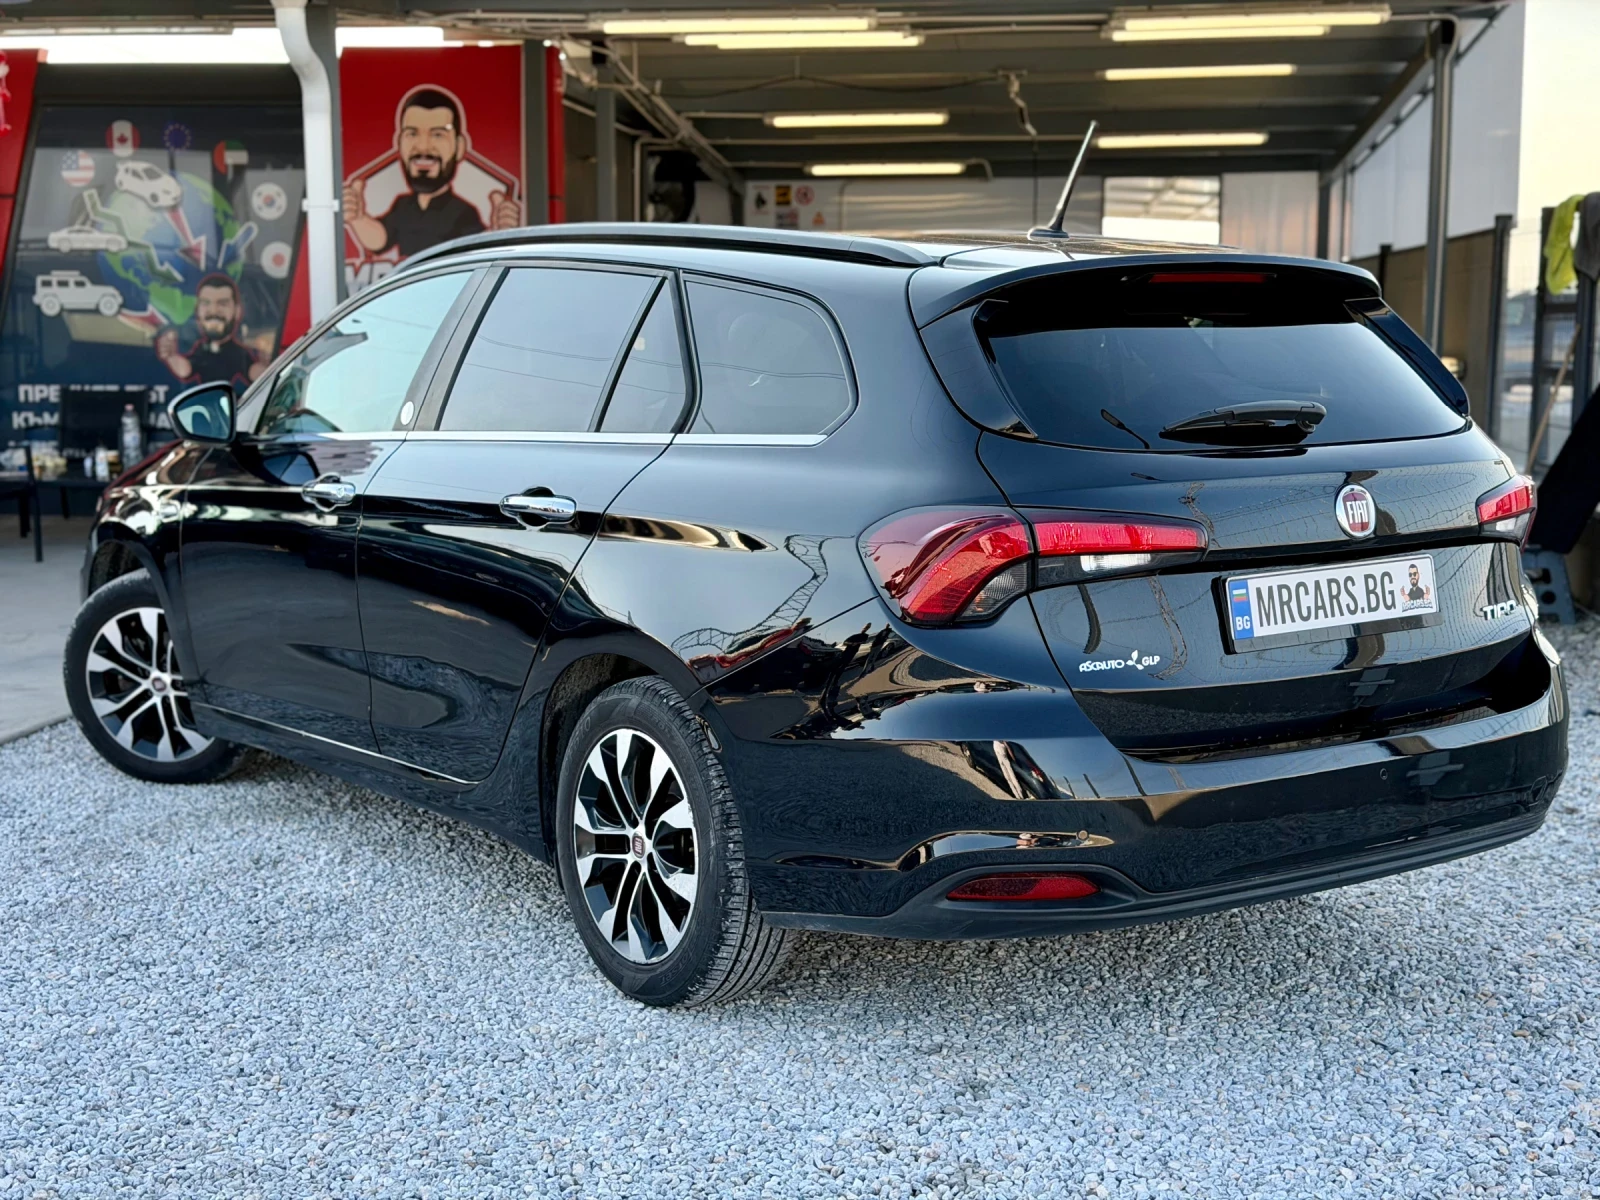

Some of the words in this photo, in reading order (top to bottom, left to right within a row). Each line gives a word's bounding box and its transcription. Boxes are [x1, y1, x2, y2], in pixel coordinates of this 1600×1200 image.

[1345, 500, 1369, 524] FIAT
[1235, 615, 1251, 631] BG
[1255, 571, 1396, 627] MRCARS.BG
[1079, 659, 1125, 672] ASCAUTO
[1141, 655, 1160, 666] GLP
